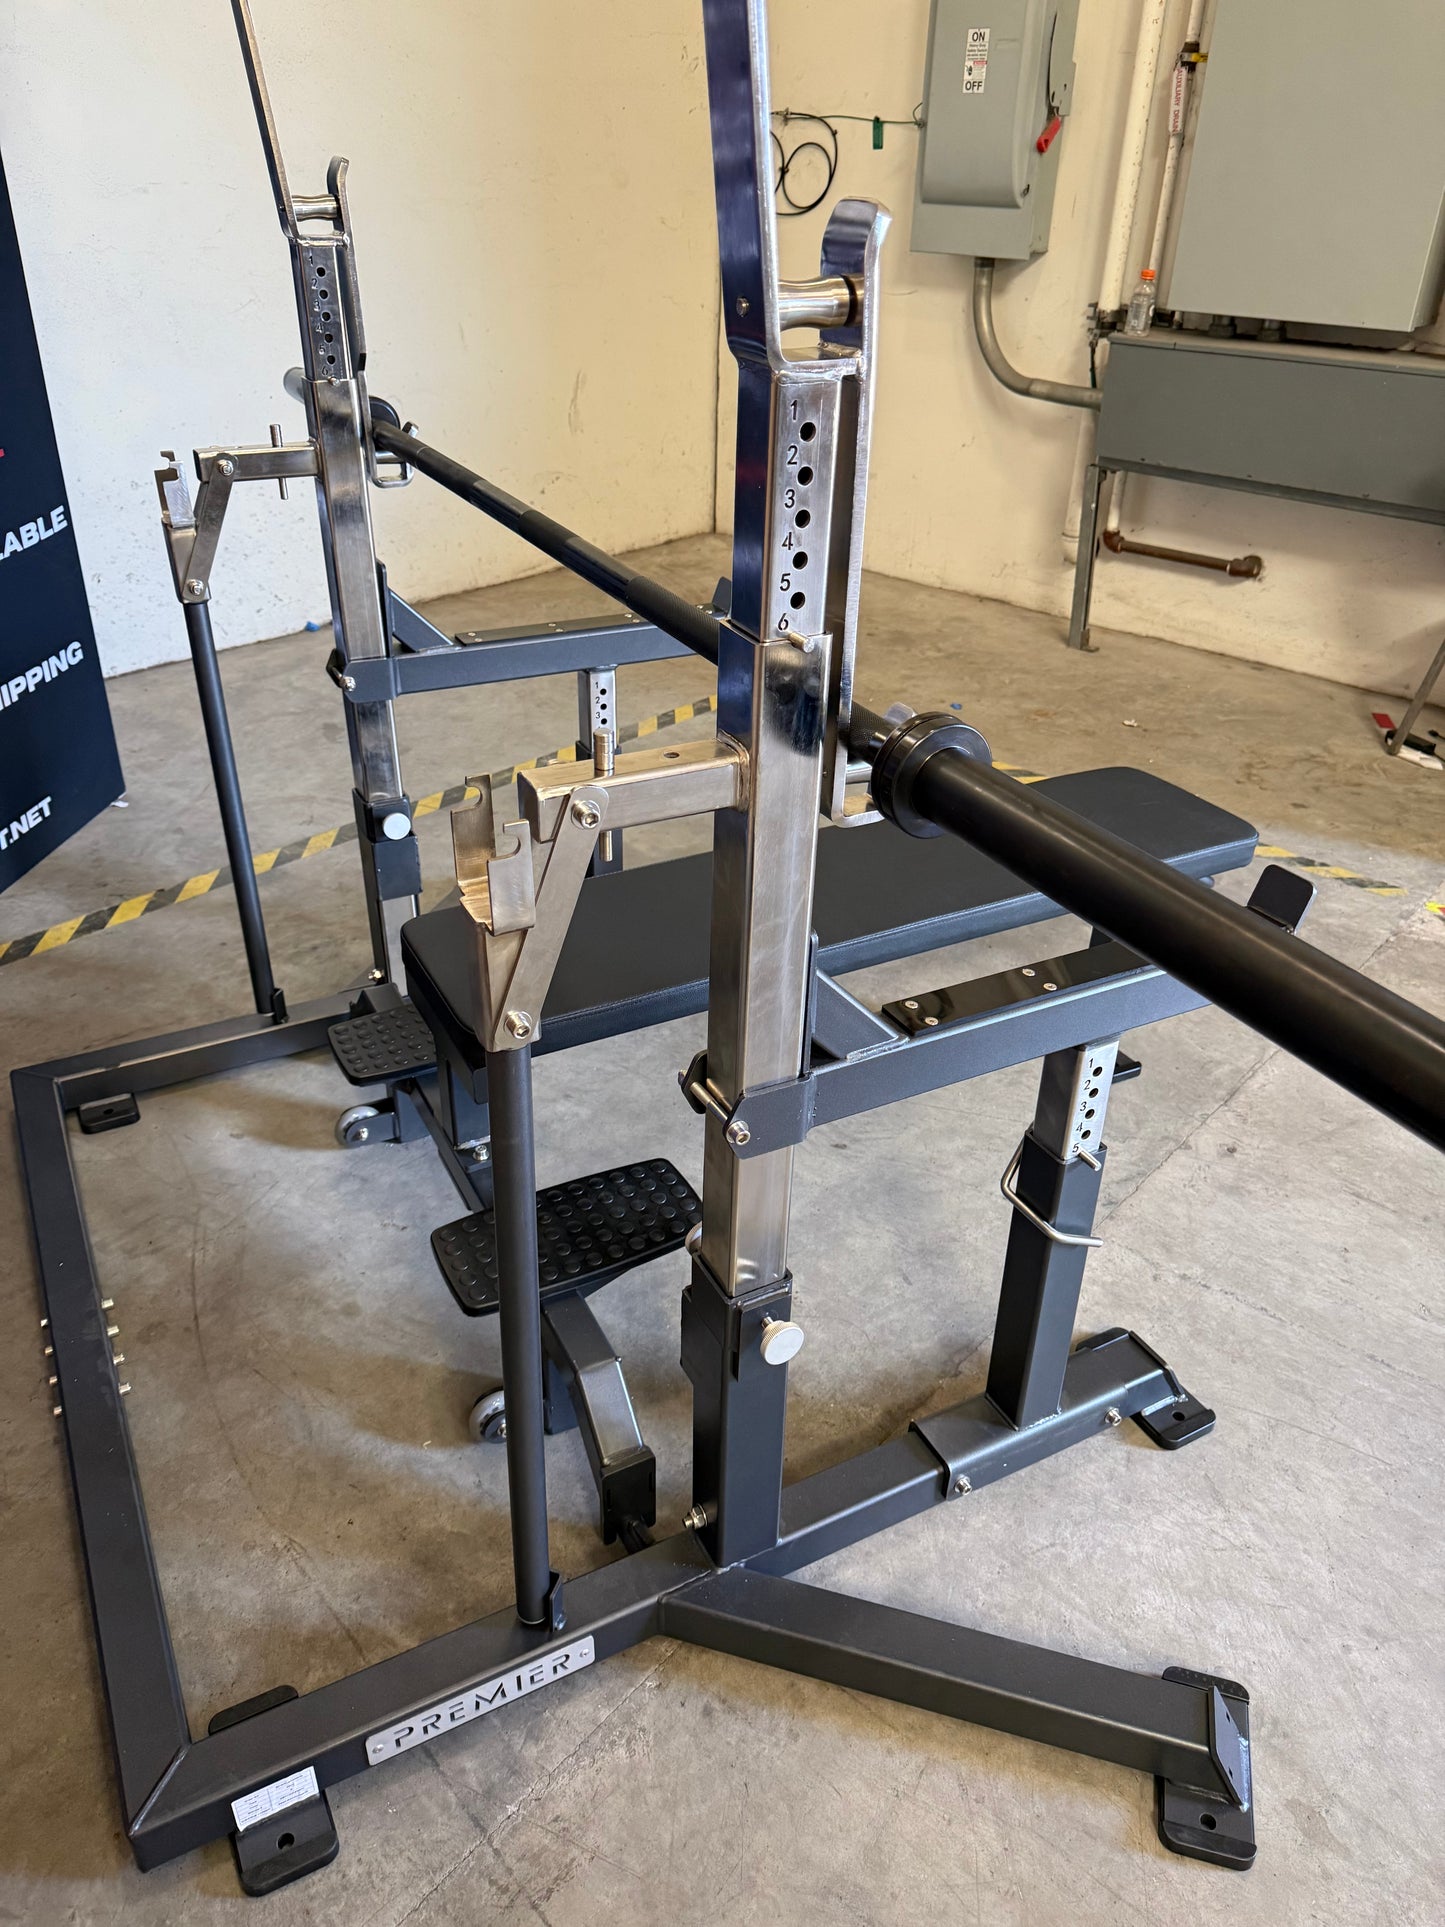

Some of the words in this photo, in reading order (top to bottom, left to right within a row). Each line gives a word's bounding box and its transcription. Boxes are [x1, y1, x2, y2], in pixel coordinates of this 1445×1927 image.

[972, 31, 985, 42] ON
[965, 81, 982, 91] OFF
[308, 255, 314, 267] 1
[311, 278, 318, 289] 2
[314, 300, 321, 312] 3
[316, 323, 324, 333] 4
[318, 344, 326, 355] 5
[321, 365, 329, 376] 6
[790, 399, 798, 420] 1
[787, 445, 798, 465] 2
[784, 488, 795, 508] 3
[0, 505, 68, 561] ABLE
[781, 531, 793, 551] 4
[779, 572, 791, 592] 5
[777, 612, 789, 631] 6
[0, 641, 84, 711] IPPING
[1088, 1057, 1094, 1068] 1
[1084, 1079, 1091, 1090] 2
[1079, 1101, 1087, 1112] 3
[1075, 1122, 1083, 1132] 4
[1072, 1143, 1080, 1153] 5
[393, 1653, 571, 1748] PREMIER
